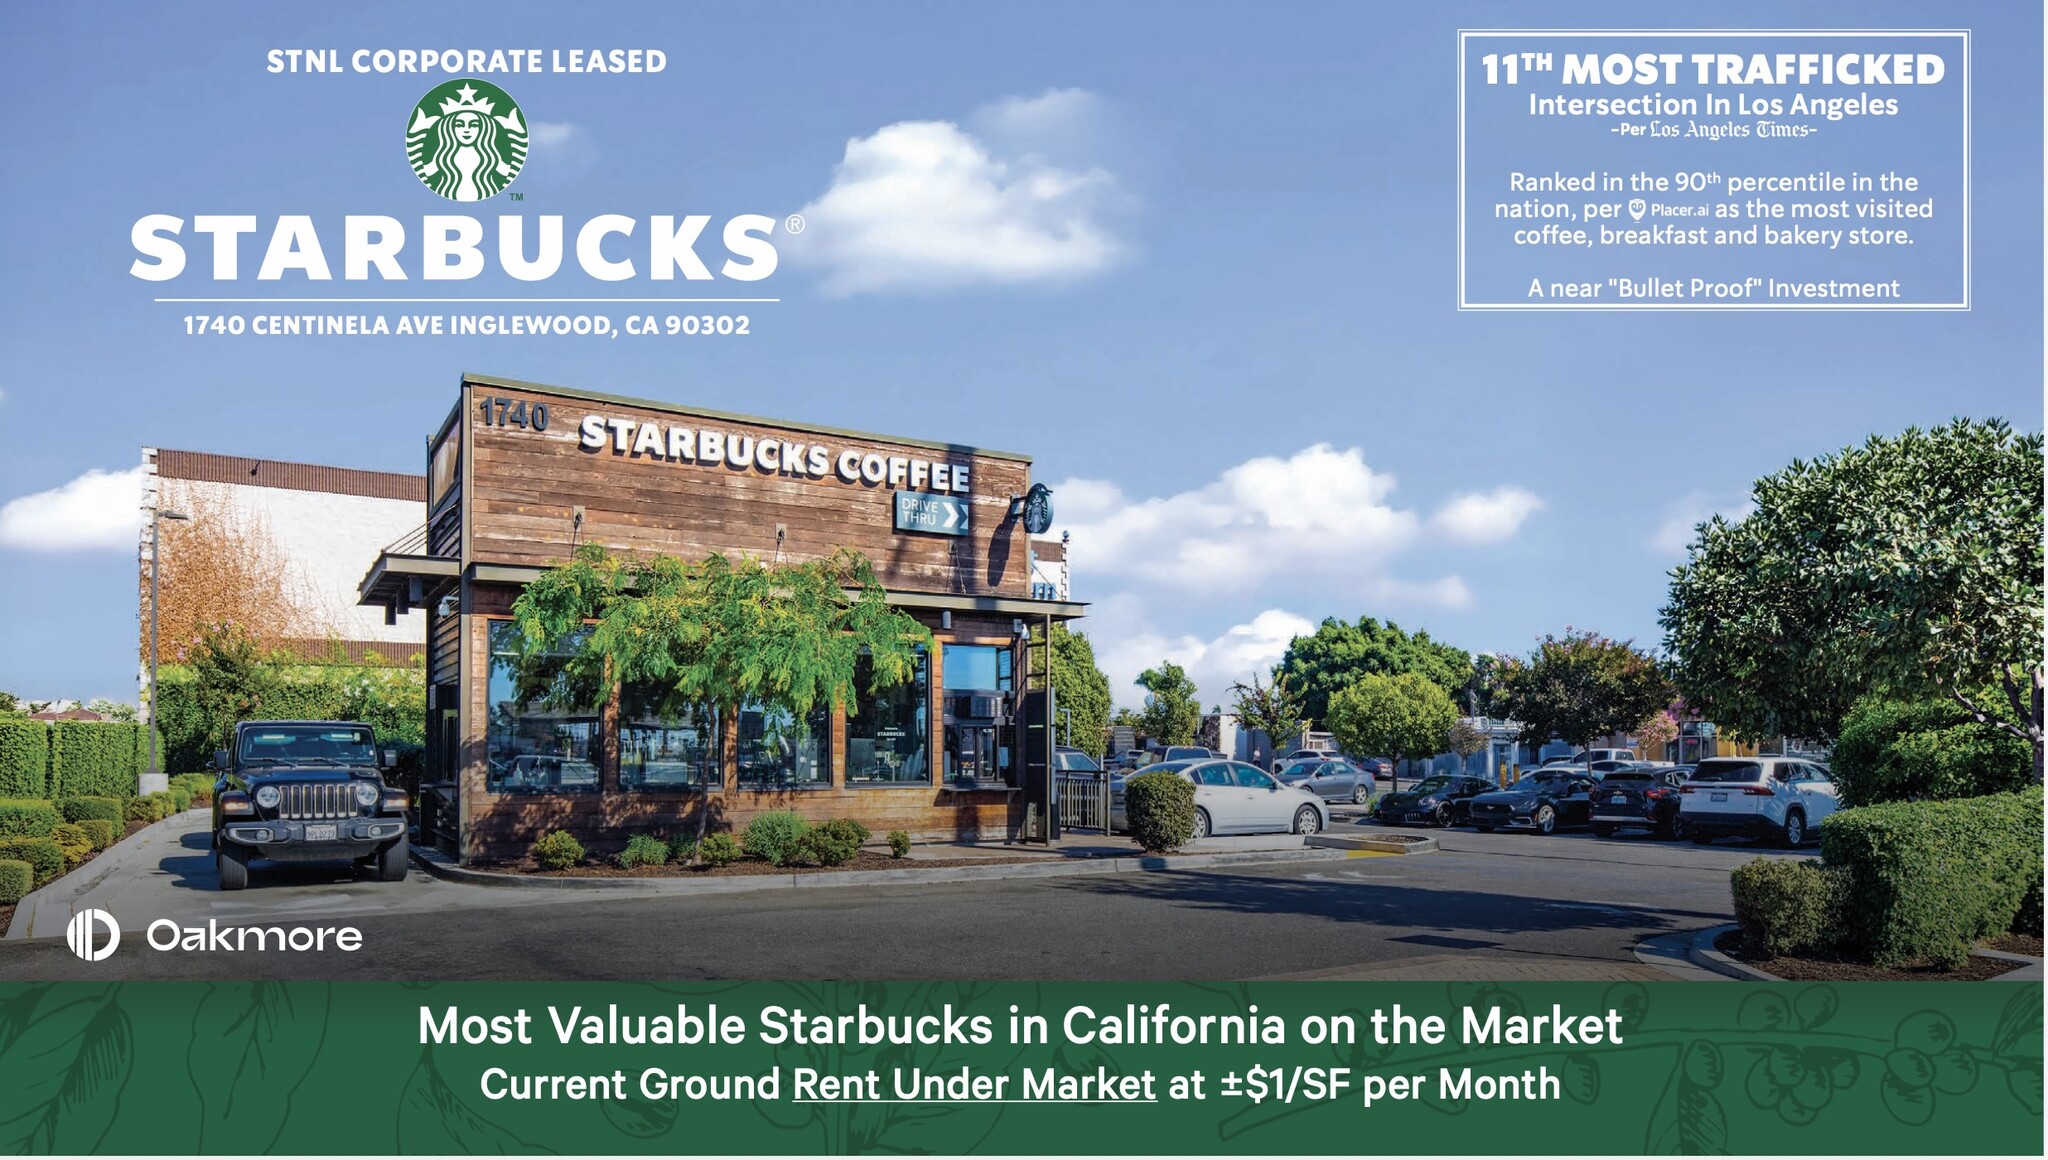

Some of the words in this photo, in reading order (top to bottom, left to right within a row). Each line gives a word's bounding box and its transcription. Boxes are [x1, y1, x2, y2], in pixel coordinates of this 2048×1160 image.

[481, 396, 549, 431] 1740
[580, 415, 830, 477] STARBUCKS
[837, 450, 970, 493] COFFEE
[902, 498, 939, 514] DRIVE
[903, 511, 937, 526] THRU
